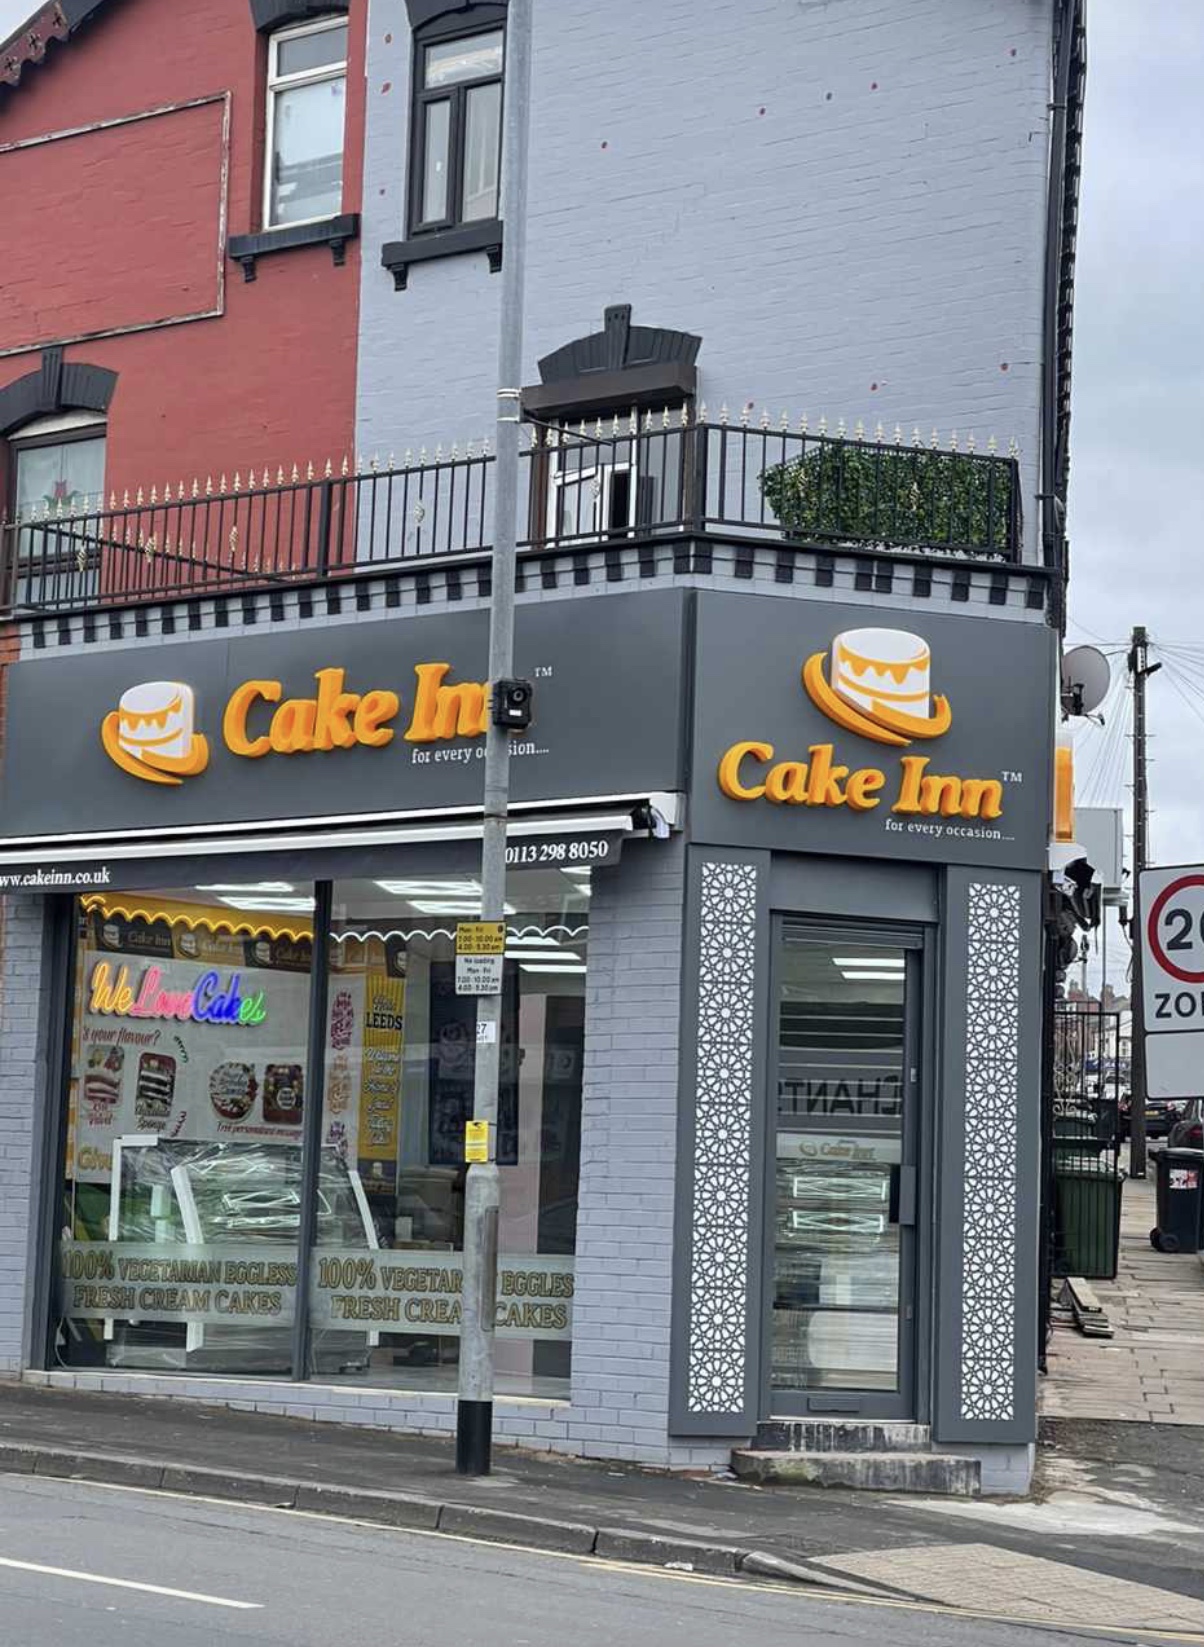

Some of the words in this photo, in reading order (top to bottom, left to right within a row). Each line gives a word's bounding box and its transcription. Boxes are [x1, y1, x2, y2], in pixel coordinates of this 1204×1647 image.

[223, 667, 398, 757] Cake
[404, 662, 493, 743] In
[412, 748, 430, 764] for
[434, 748, 473, 764] every
[717, 741, 886, 812] Cake
[891, 756, 1003, 820] Inn
[1002, 771, 1023, 783] TM
[885, 818, 904, 832] for
[907, 821, 943, 839] every
[505, 846, 537, 863] 0113
[539, 843, 565, 860] 298
[567, 840, 609, 859] 8050
[1164, 909, 1204, 950] 2
[88, 961, 134, 1015] We
[191, 969, 268, 1026] Cakes
[1155, 991, 1204, 1019] ZO
[365, 1013, 403, 1031] LEEDS
[61, 1250, 114, 1281] 100%
[118, 1257, 221, 1284] VEGETARIAN
[224, 1260, 297, 1287] EGGLESS
[318, 1256, 377, 1290] 100%
[380, 1266, 463, 1293] VEGETAR
[501, 1270, 575, 1298] EGGLES
[73, 1285, 136, 1310] FRESH
[139, 1286, 210, 1312] CREAM
[214, 1290, 282, 1316] CAKES
[330, 1294, 401, 1320] FRESH
[405, 1298, 463, 1324] CREA
